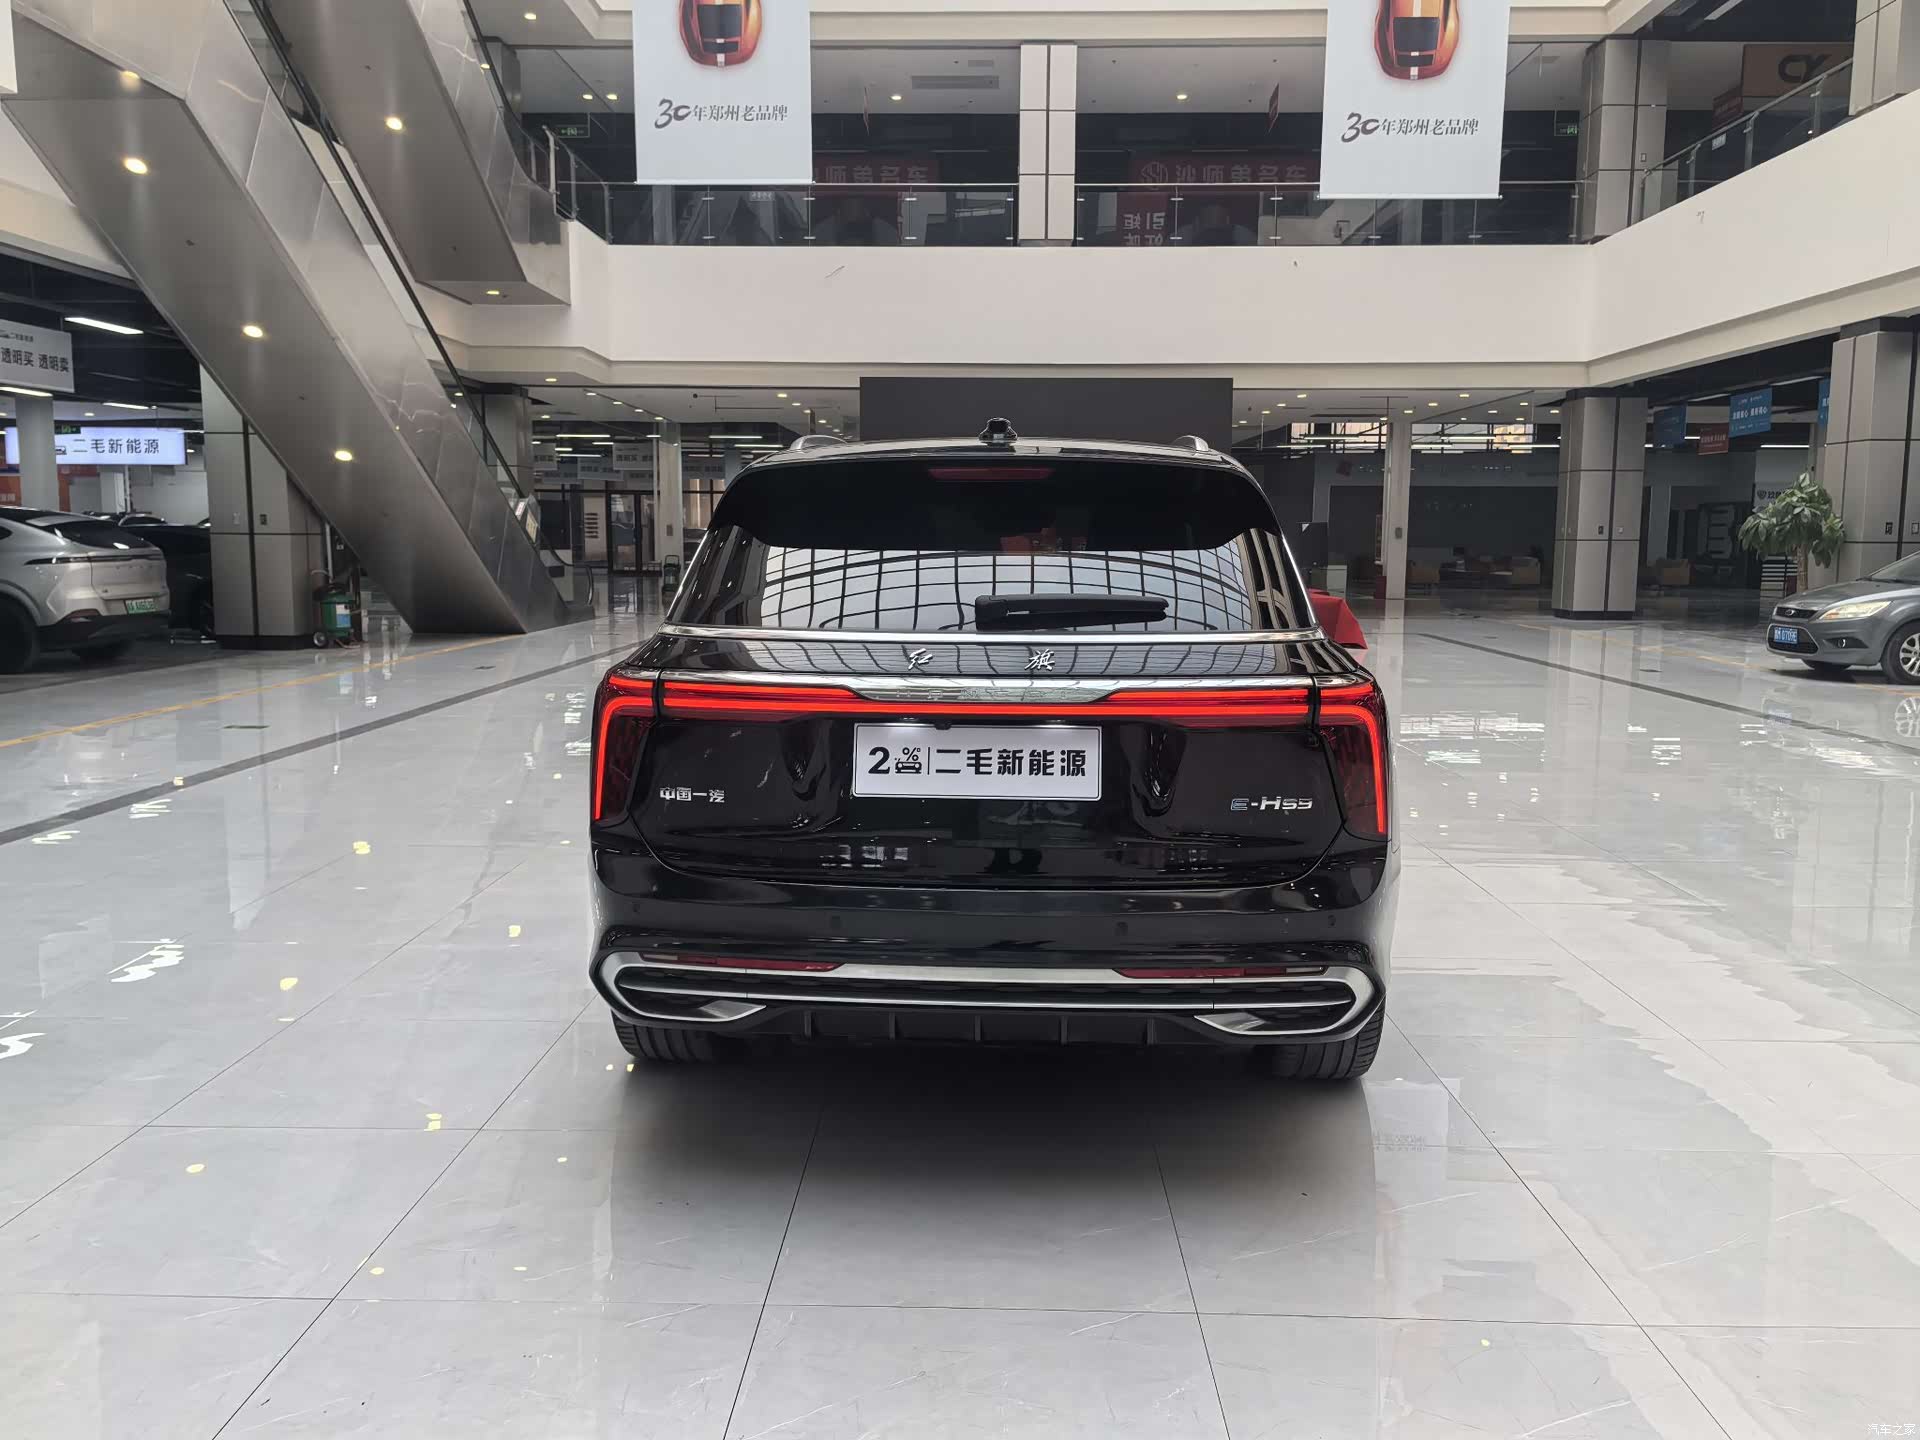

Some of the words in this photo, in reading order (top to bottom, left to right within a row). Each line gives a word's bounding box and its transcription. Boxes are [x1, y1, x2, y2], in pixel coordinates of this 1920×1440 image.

[654, 98, 788, 129] 30年郑州老品牌
[1341, 112, 1479, 143] 30年郑州老品牌
[815, 165, 928, 183] 师弟名车
[73, 438, 160, 455] 二毛新能源
[908, 647, 1055, 672] 红旗
[935, 748, 1087, 777] 二毛新能源
[659, 786, 725, 803] 中国一汽
